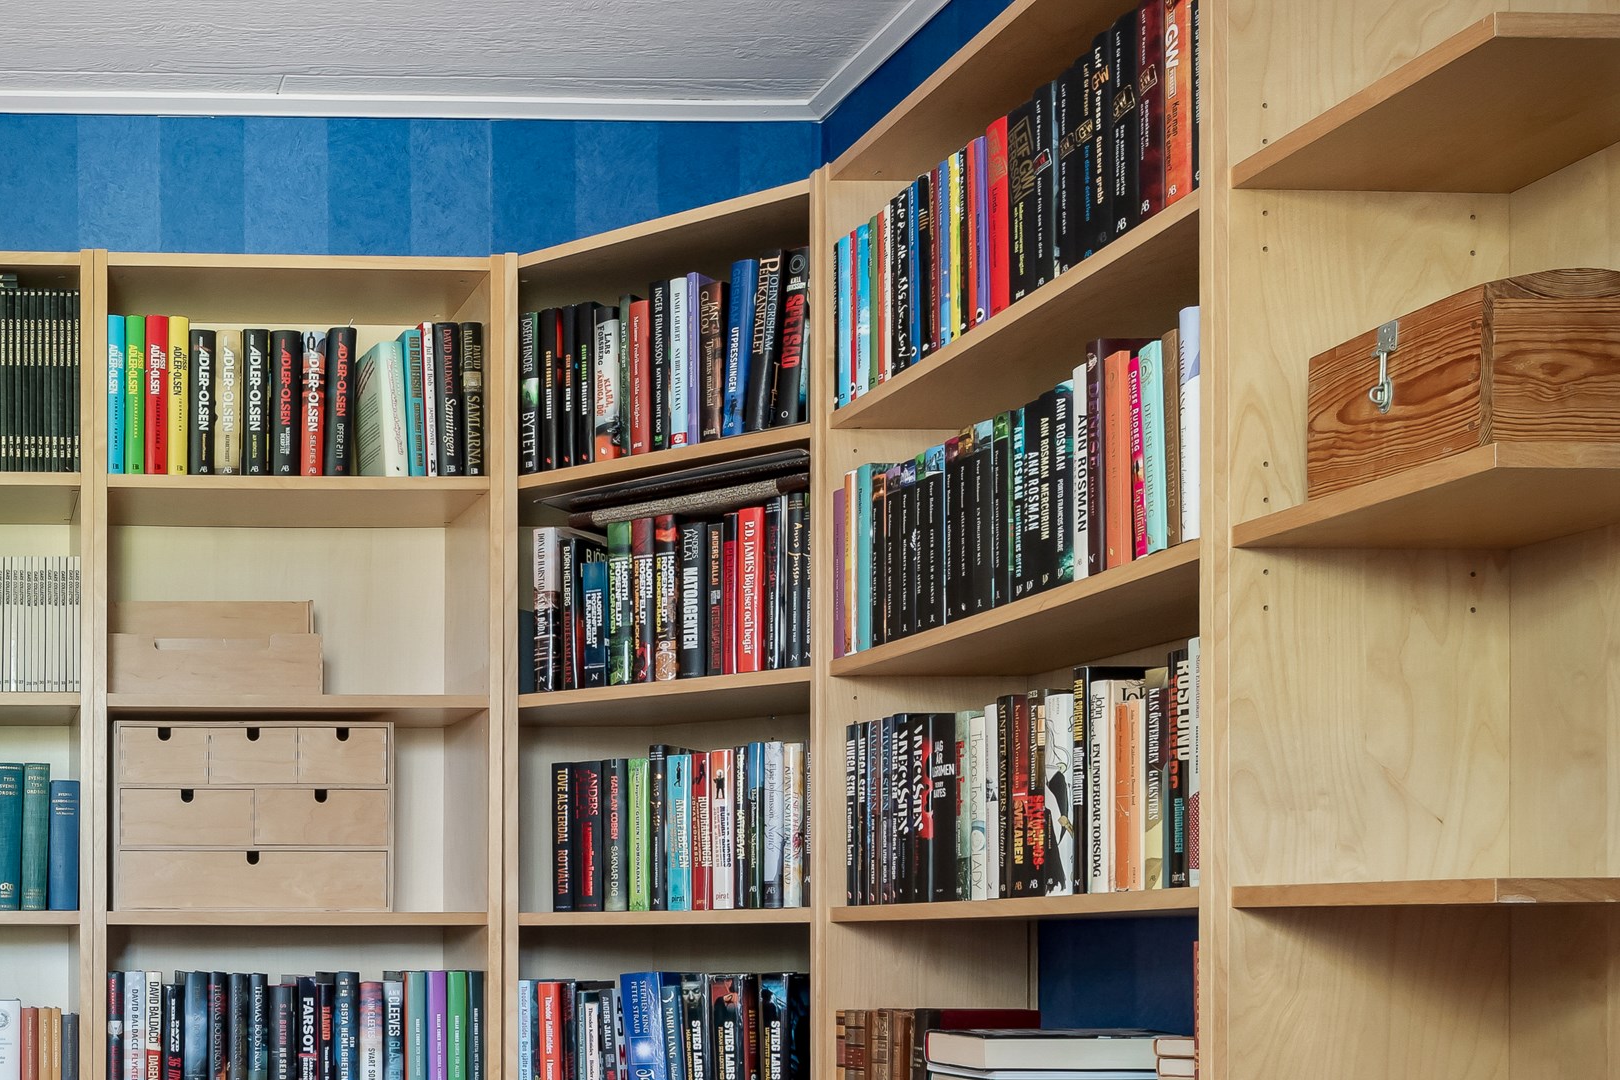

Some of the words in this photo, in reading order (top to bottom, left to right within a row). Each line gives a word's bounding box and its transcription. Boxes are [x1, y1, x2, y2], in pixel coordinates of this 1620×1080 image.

[753, 255, 780, 354] PELIKANFALLET
[769, 274, 779, 301] JOHN
[522, 318, 533, 343] JOSEPH
[700, 291, 709, 334] GUILLOU
[708, 302, 719, 320] JAN
[765, 303, 776, 350] GRISHAM
[443, 329, 452, 353] DAVID
[464, 330, 472, 369] BALDACCI
[597, 325, 605, 365] FORSBERG
[781, 294, 804, 368] SPETSAD
[444, 355, 452, 394] BALDACCI
[523, 345, 532, 373] FINDER
[729, 327, 739, 392] UTPRESSNINGEN
[249, 346, 261, 431] ADLER-OLSEN
[281, 348, 291, 425] ADLER-OLSEN
[308, 349, 319, 432] ADLER-OLSEN
[604, 379, 613, 407] KLARA,
[443, 398, 456, 456] Sanningen
[467, 395, 480, 466] SAMLARNA
[523, 412, 535, 455] BYTET
[1041, 417, 1049, 436] ANN
[1028, 452, 1039, 475] ANN
[1041, 438, 1049, 478] ROSMAN
[1029, 478, 1039, 531] ROSMAN
[1041, 483, 1049, 540] MERCURIUM
[744, 521, 754, 539] P.D.
[744, 541, 755, 572] JAMES
[683, 567, 698, 649] NATOAGENTEN
[743, 574, 754, 611] Böjelser
[744, 612, 753, 627] och
[743, 629, 754, 654] begär
[1149, 688, 1159, 710] KLAS
[1093, 743, 1100, 757] EN
[1148, 713, 1160, 763] ÖSTERGREN
[557, 768, 568, 792] TOVE
[1093, 760, 1101, 820] UNDERBAR
[1149, 770, 1159, 820] GANGSTERS
[558, 794, 568, 844] ALSTERDAL
[1014, 800, 1024, 864] SVIKAREN
[1093, 823, 1101, 877] TORSDAG
[149, 982, 159, 1004] DAVID
[640, 980, 648, 1011] STEPHEN
[149, 1007, 159, 1044] BALDACCI
[303, 997, 313, 1053] FARSOT
[388, 997, 399, 1036] CLEEVES
[692, 1020, 701, 1050] STIEG
[149, 1055, 159, 1080] DAGEN
